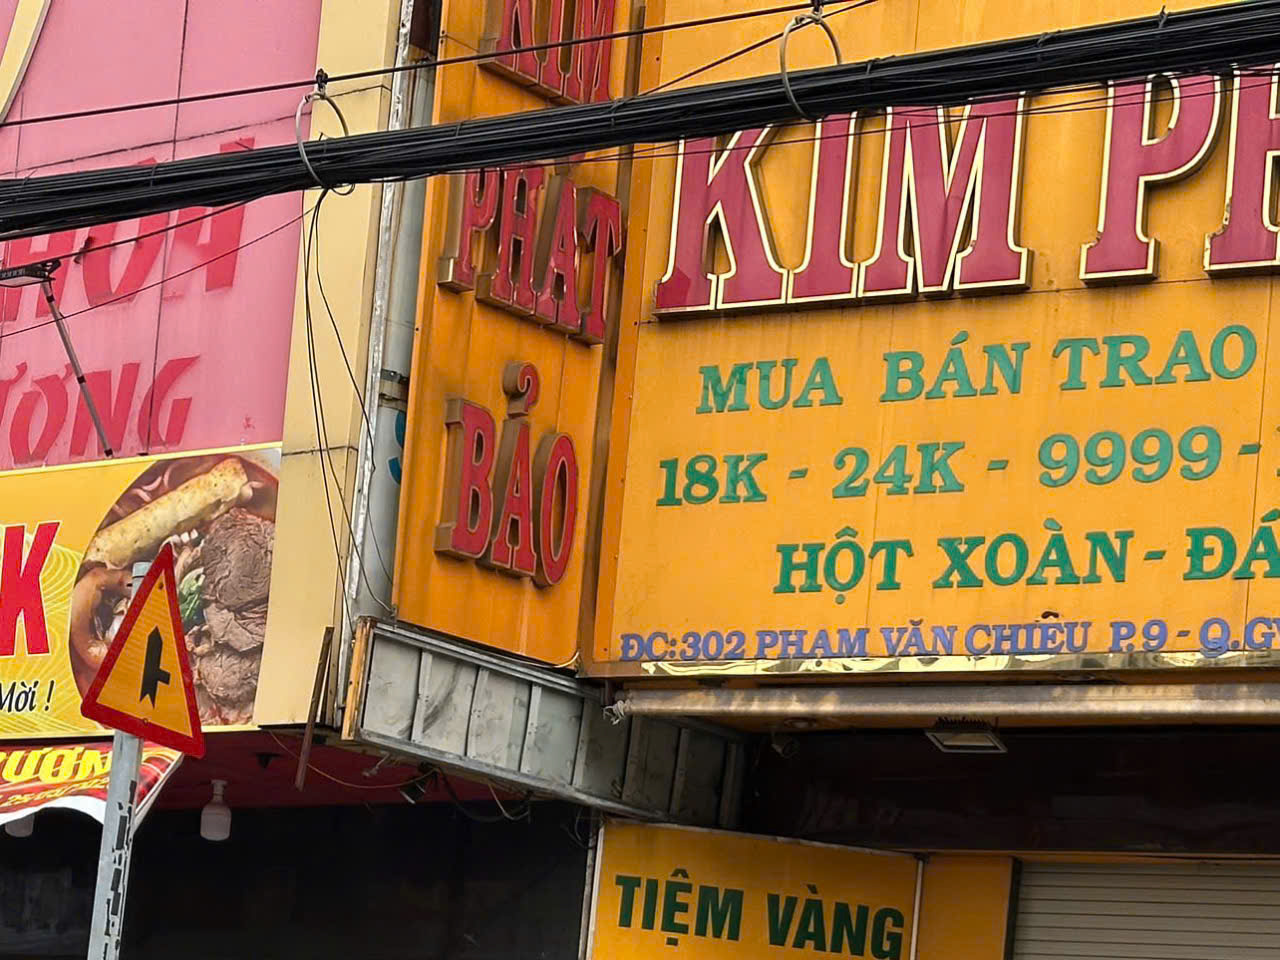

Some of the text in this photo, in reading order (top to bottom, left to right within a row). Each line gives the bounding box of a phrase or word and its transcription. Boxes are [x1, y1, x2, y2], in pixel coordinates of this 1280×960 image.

[654, 92, 1031, 315] KIM
[695, 324, 1257, 416] MUA BÁN TRAO
[435, 361, 578, 587] BẢO
[656, 453, 767, 507] 18K
[832, 441, 965, 499] 24K
[1038, 425, 1223, 488] 9999
[773, 528, 914, 605] HỘT
[931, 517, 1134, 590] XOÀN
[1182, 508, 1280, 580] ĐÁ
[621, 631, 745, 661] ĐC:302
[755, 627, 867, 668] PHẠM
[880, 618, 959, 656] VĂN
[1108, 617, 1166, 652] P.9
[614, 868, 743, 946] TIỆM
